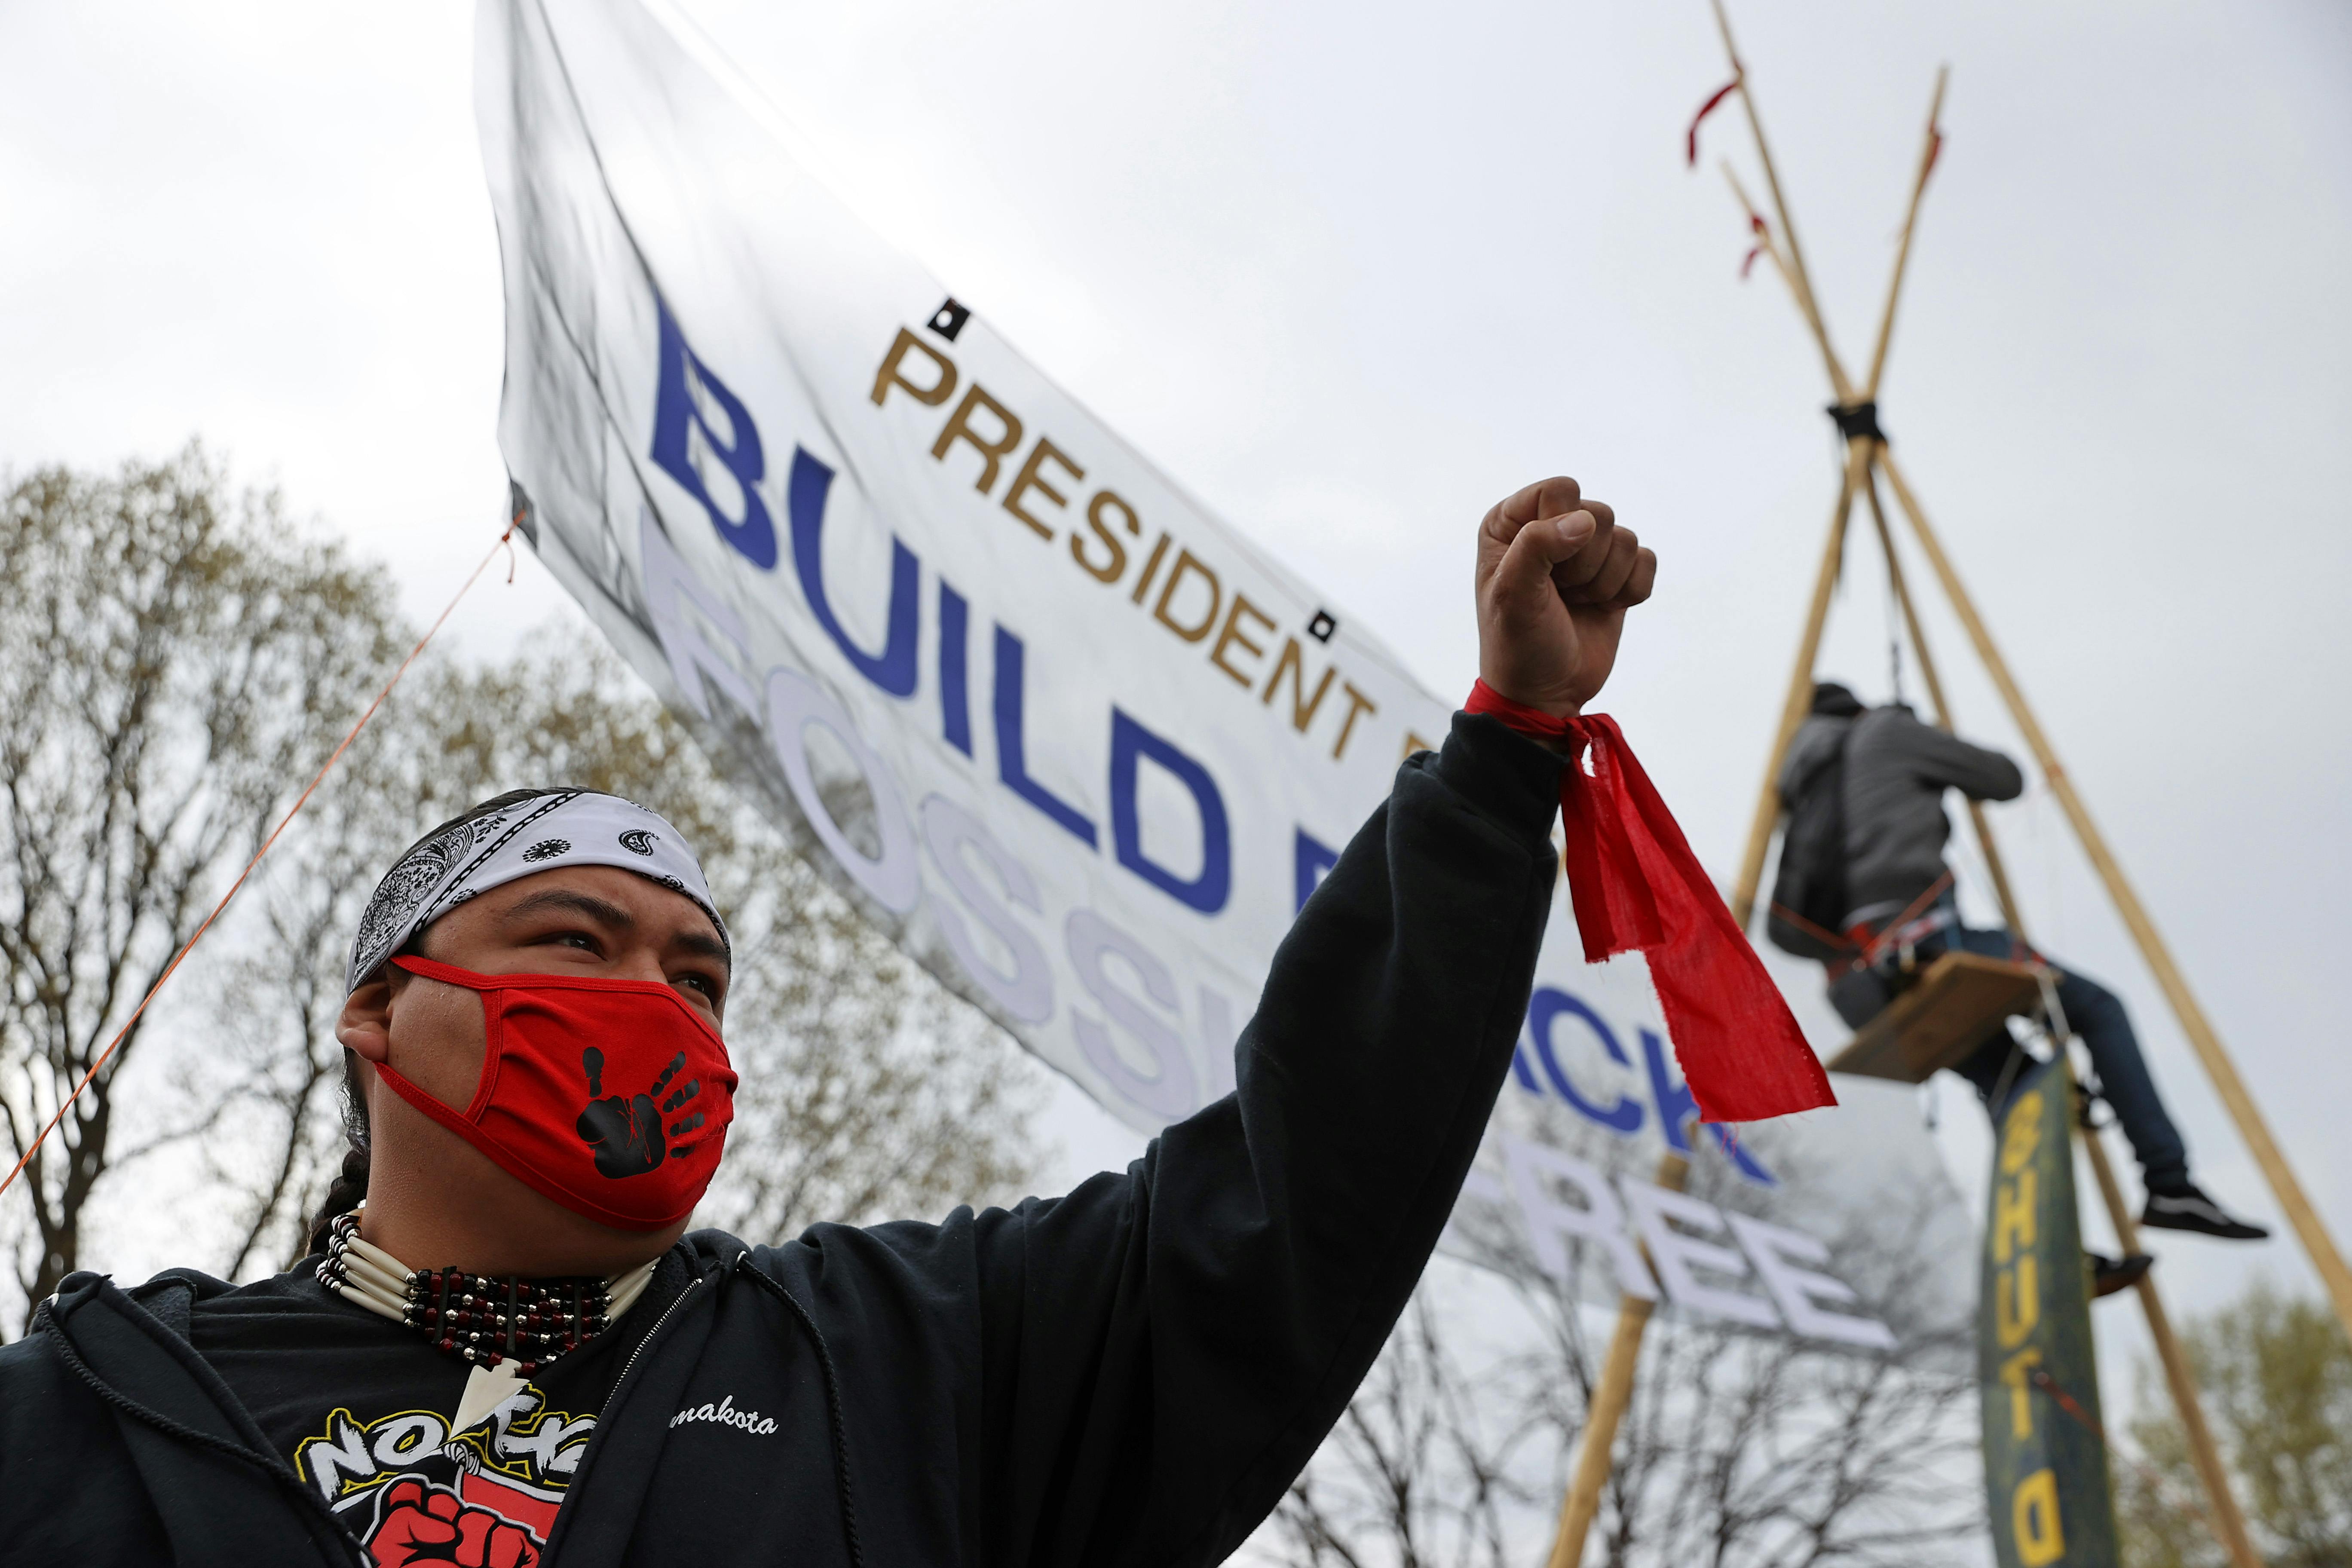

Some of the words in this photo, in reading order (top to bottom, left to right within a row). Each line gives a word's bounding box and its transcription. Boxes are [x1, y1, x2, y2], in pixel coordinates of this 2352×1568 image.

[870, 327, 1377, 761] PRESIDENT
[650, 286, 1231, 917] BUILD
[1295, 824, 1779, 1186] CK
[1448, 1133, 1899, 1350] REE
[307, 1413, 444, 1504] NO
